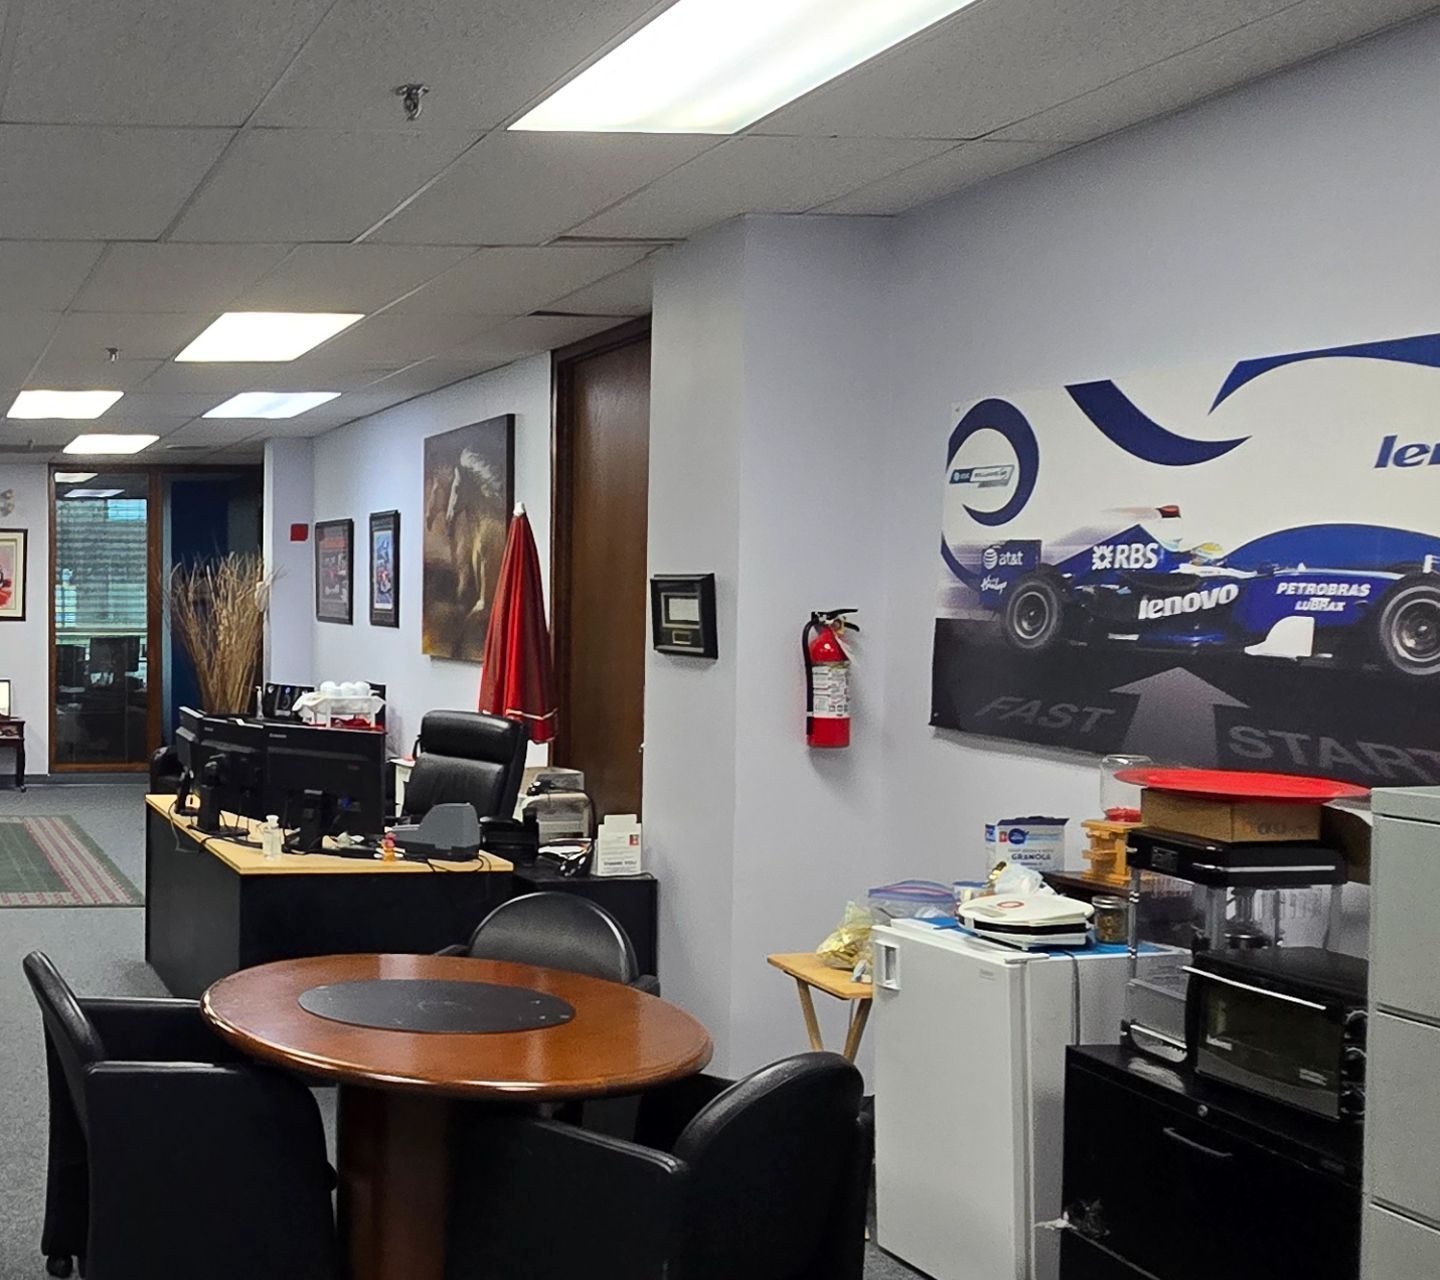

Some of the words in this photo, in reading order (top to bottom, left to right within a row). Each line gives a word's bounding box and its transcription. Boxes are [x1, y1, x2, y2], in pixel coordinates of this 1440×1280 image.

[998, 551, 1023, 566] at&t
[1113, 543, 1159, 569] RBS
[1138, 583, 1239, 620] lenovo
[1276, 582, 1371, 596] PETROBRAS
[975, 696, 1116, 733] FAST
